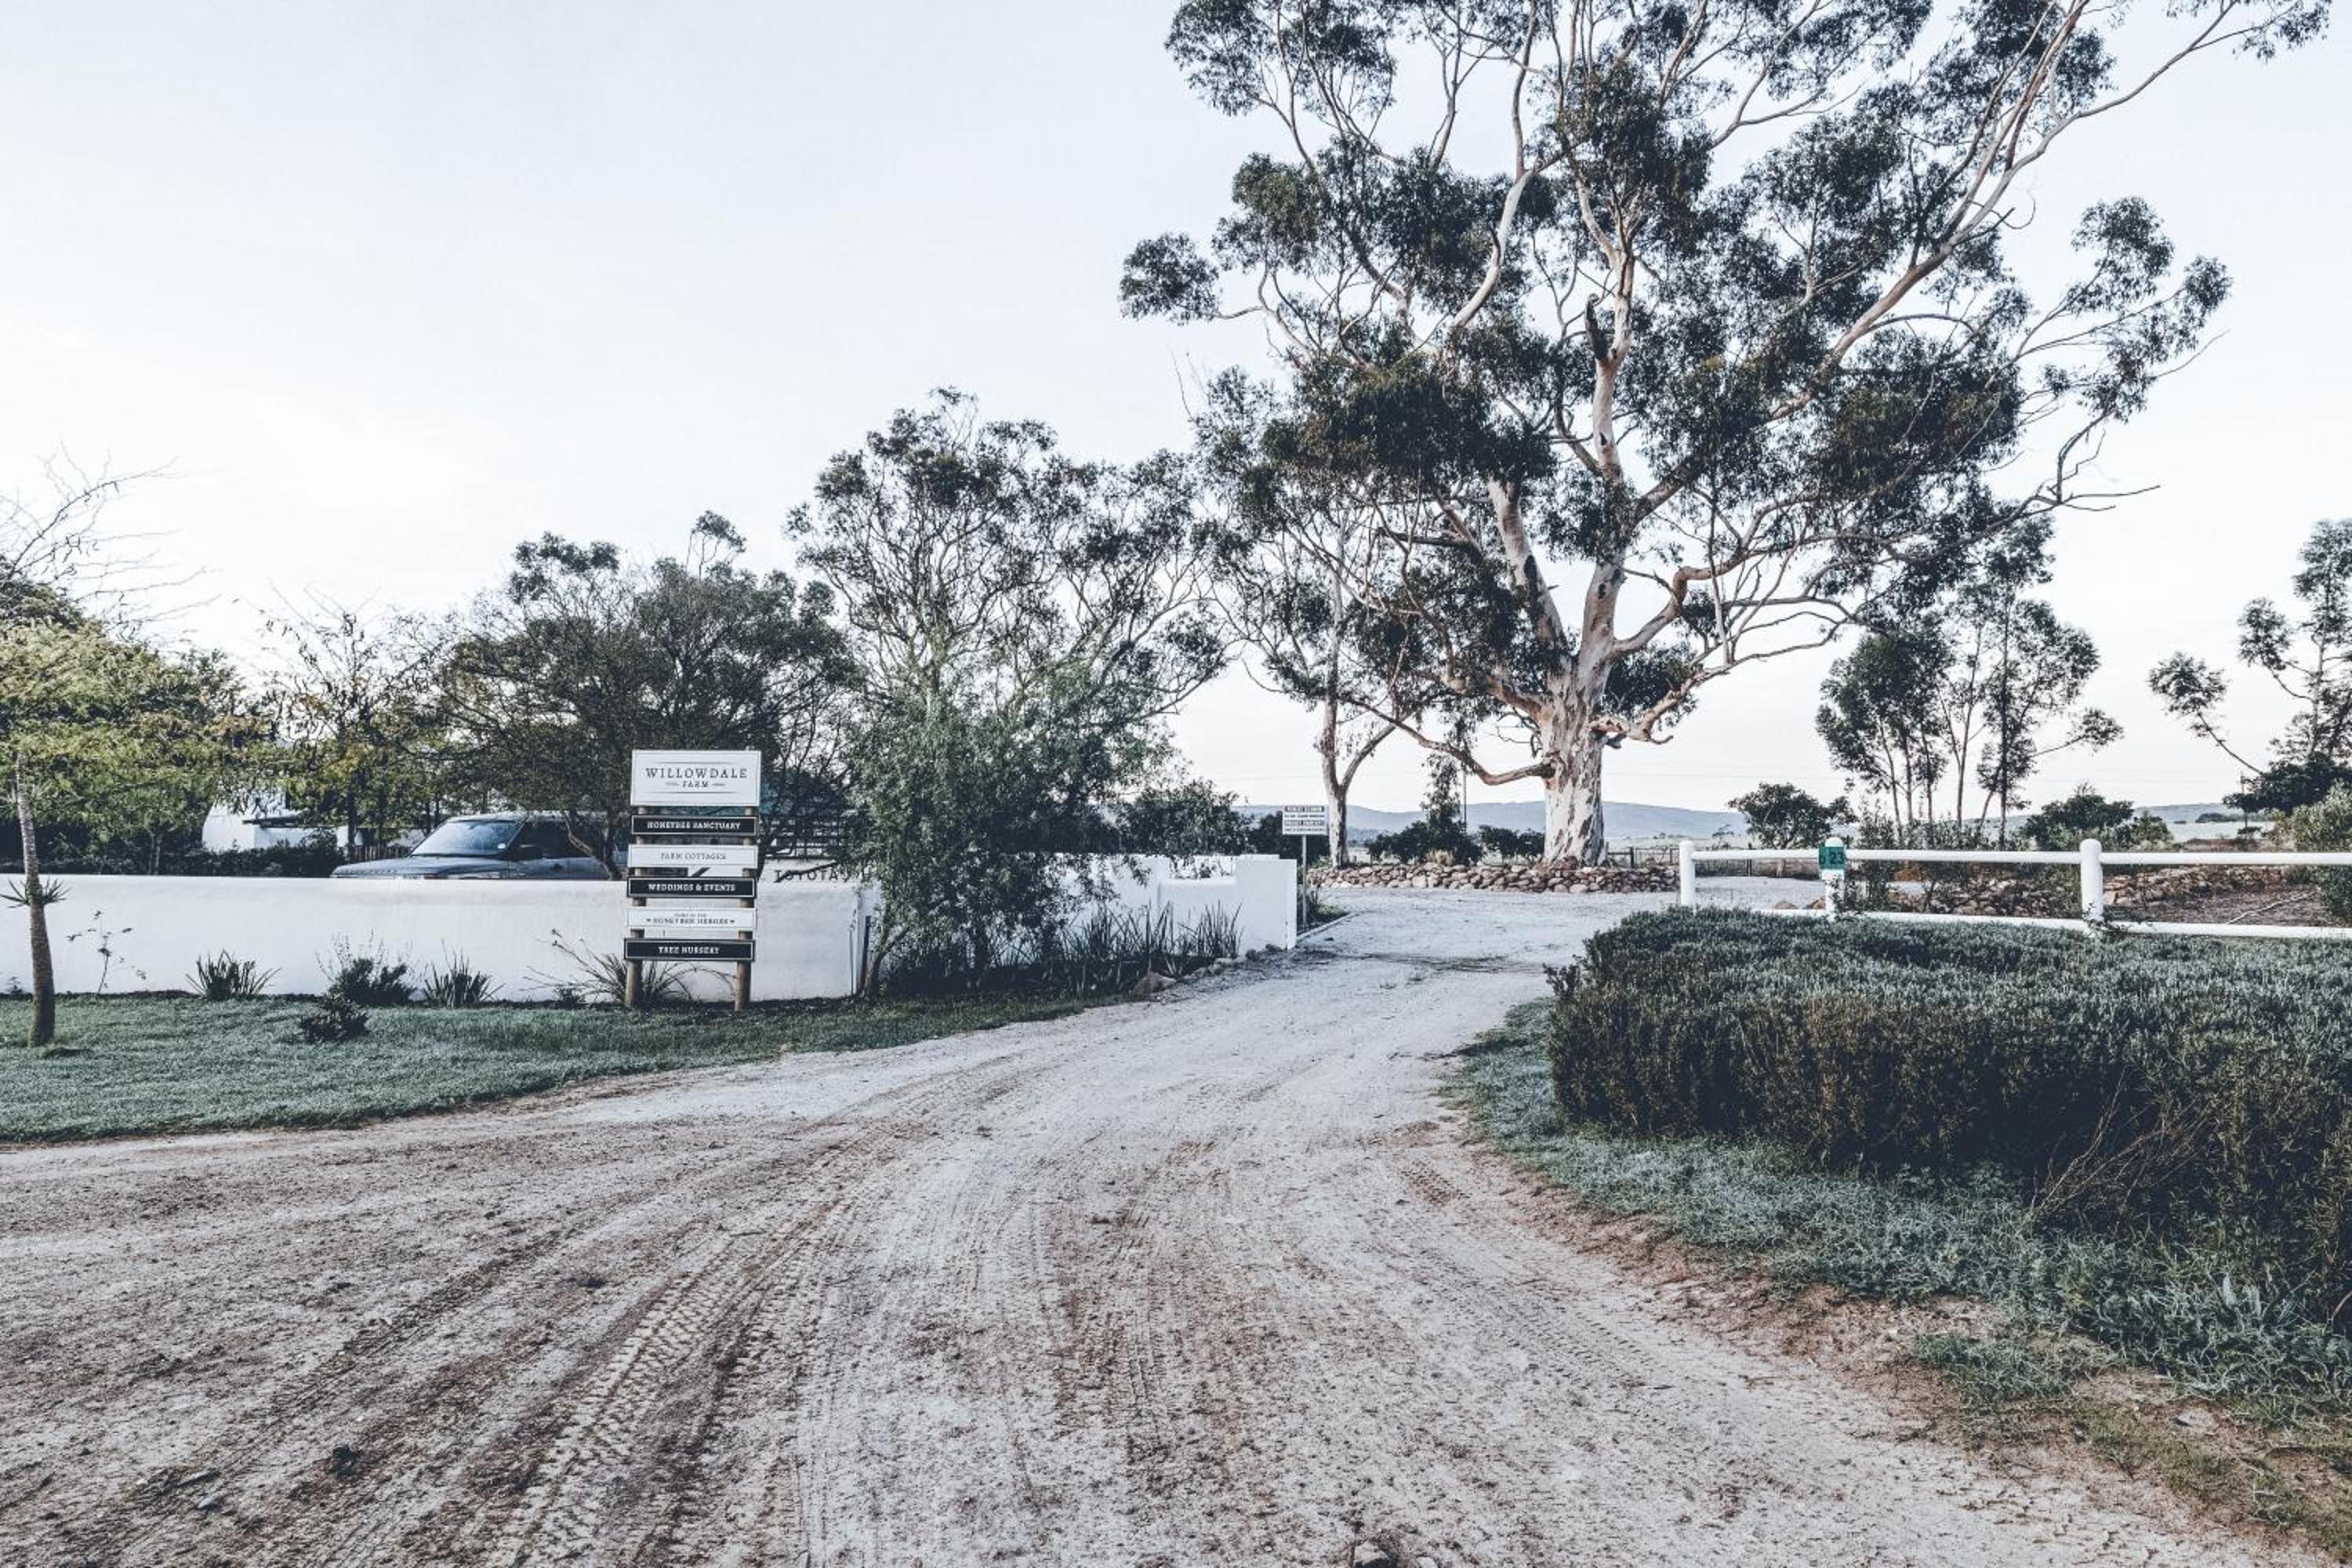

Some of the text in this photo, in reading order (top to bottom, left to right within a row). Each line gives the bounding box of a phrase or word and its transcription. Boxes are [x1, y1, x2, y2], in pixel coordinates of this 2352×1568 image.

[645, 768, 748, 779] WILLOWDALE
[692, 822, 741, 830] SANCTUARY
[1829, 851, 1844, 864] 23
